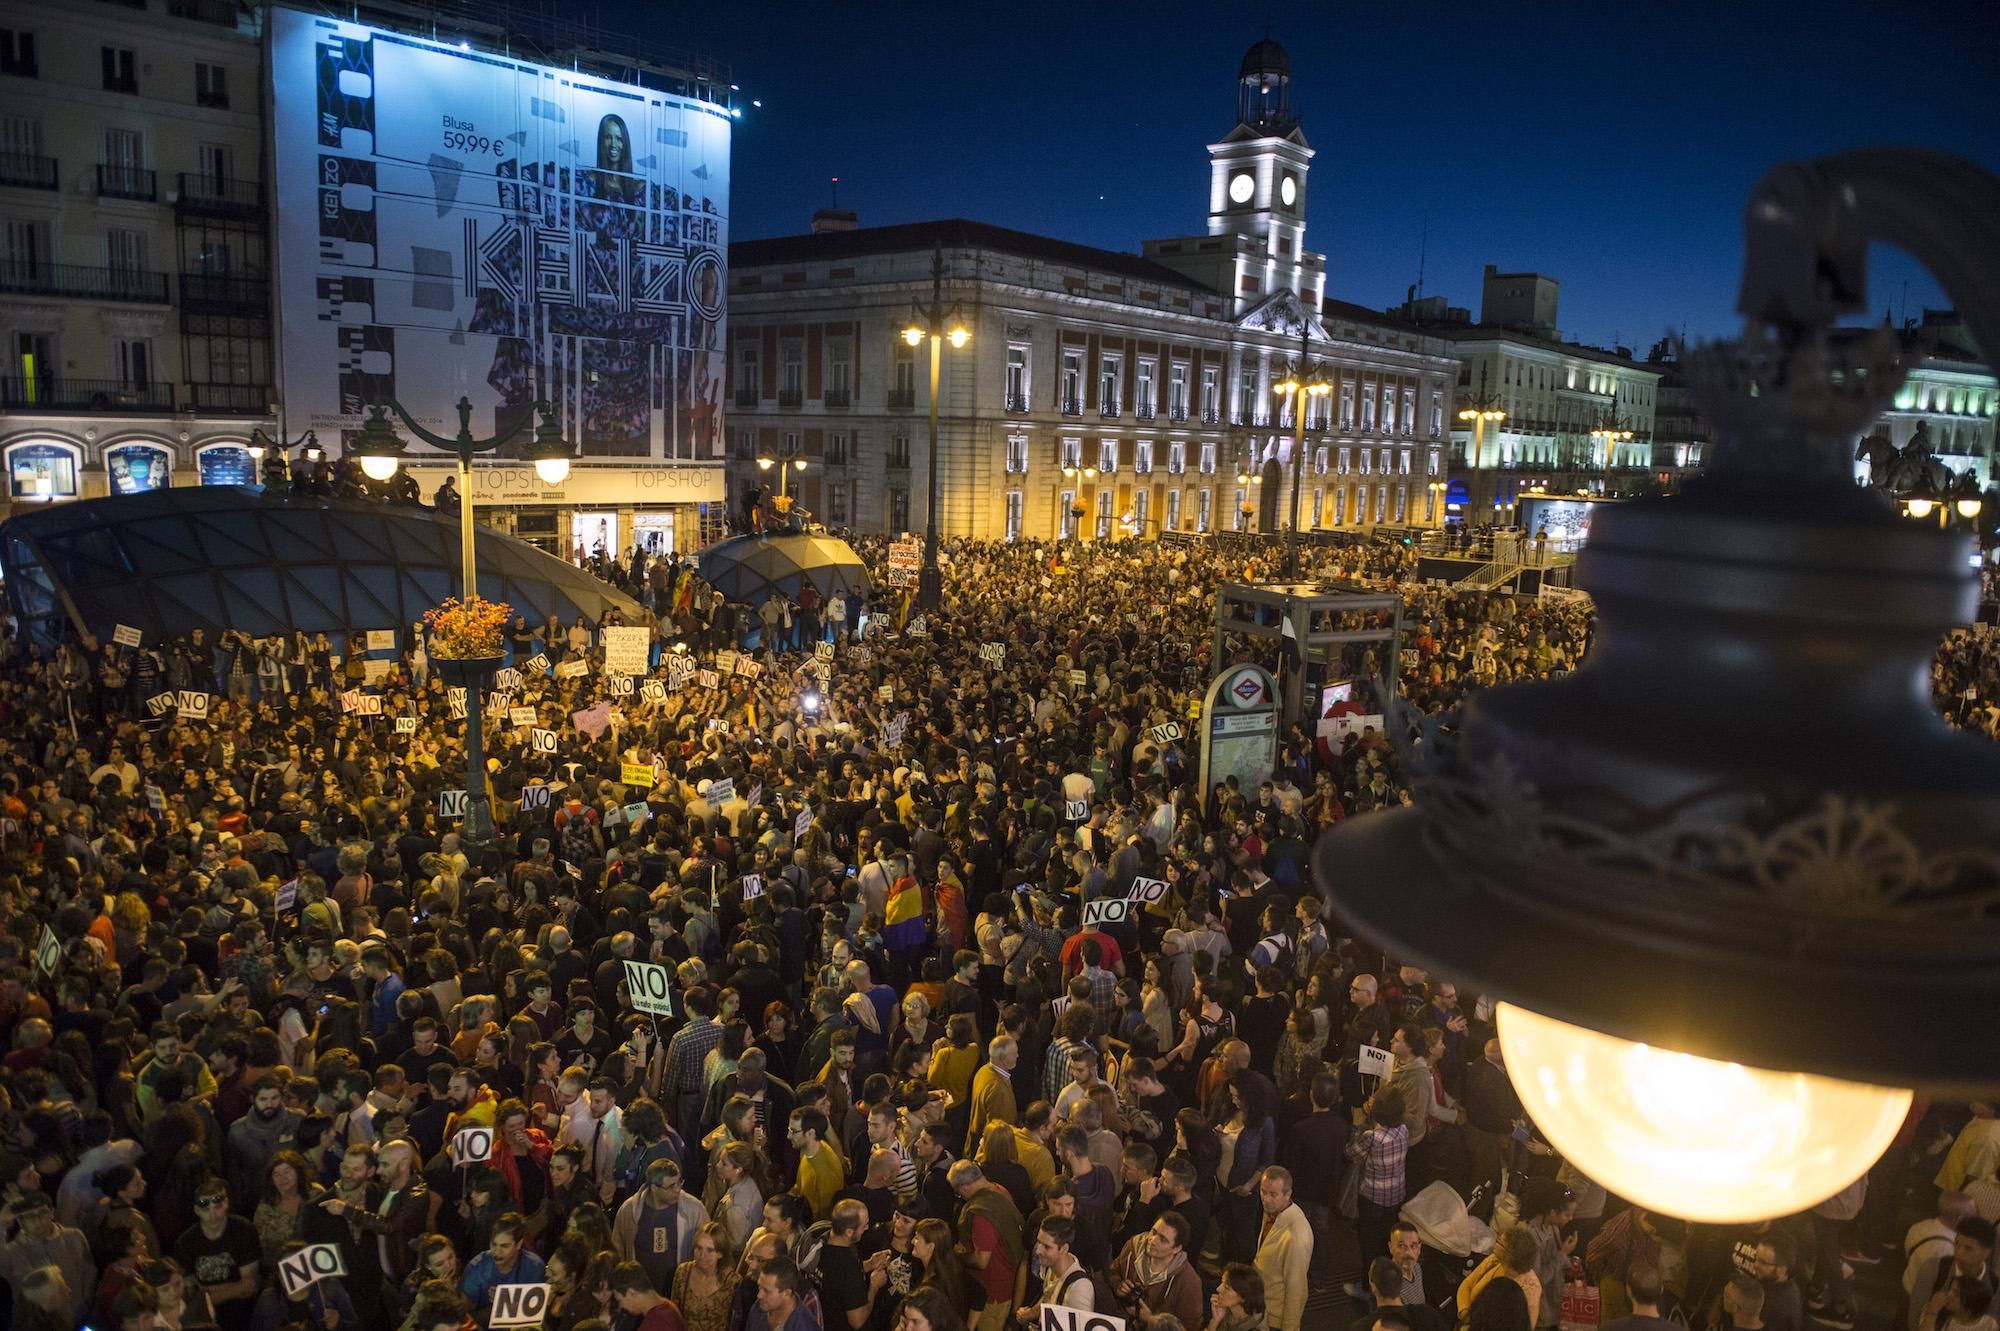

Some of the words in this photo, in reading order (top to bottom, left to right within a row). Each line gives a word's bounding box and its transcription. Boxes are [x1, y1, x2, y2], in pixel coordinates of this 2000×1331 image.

[443, 115, 474, 132] Blusa
[443, 132, 489, 155] 59,99
[493, 140, 505, 157] €
[324, 158, 339, 219] KENZO
[464, 218, 728, 322] KENZO
[632, 471, 712, 488] TOPSHOP
[874, 613, 888, 625] NO
[818, 642, 834, 656] NO
[528, 656, 548, 672] NO
[738, 661, 758, 675] NO
[612, 679, 633, 693] NO
[701, 670, 717, 687] NO
[180, 692, 206, 710] NO
[343, 691, 358, 711] NO
[490, 694, 508, 710] NO
[641, 685, 664, 704] NO
[148, 694, 175, 714] NO
[398, 719, 414, 729] NO
[1154, 724, 1179, 741] NO
[534, 732, 555, 751] NO
[523, 787, 550, 810] NO
[1068, 803, 1085, 818] NO
[745, 877, 760, 898] NO
[1131, 880, 1164, 900] NO
[1085, 901, 1125, 922] NO
[626, 964, 666, 999] NO
[1367, 1049, 1386, 1062] NO!
[283, 1246, 337, 1291] NO
[495, 1286, 546, 1319] NO
